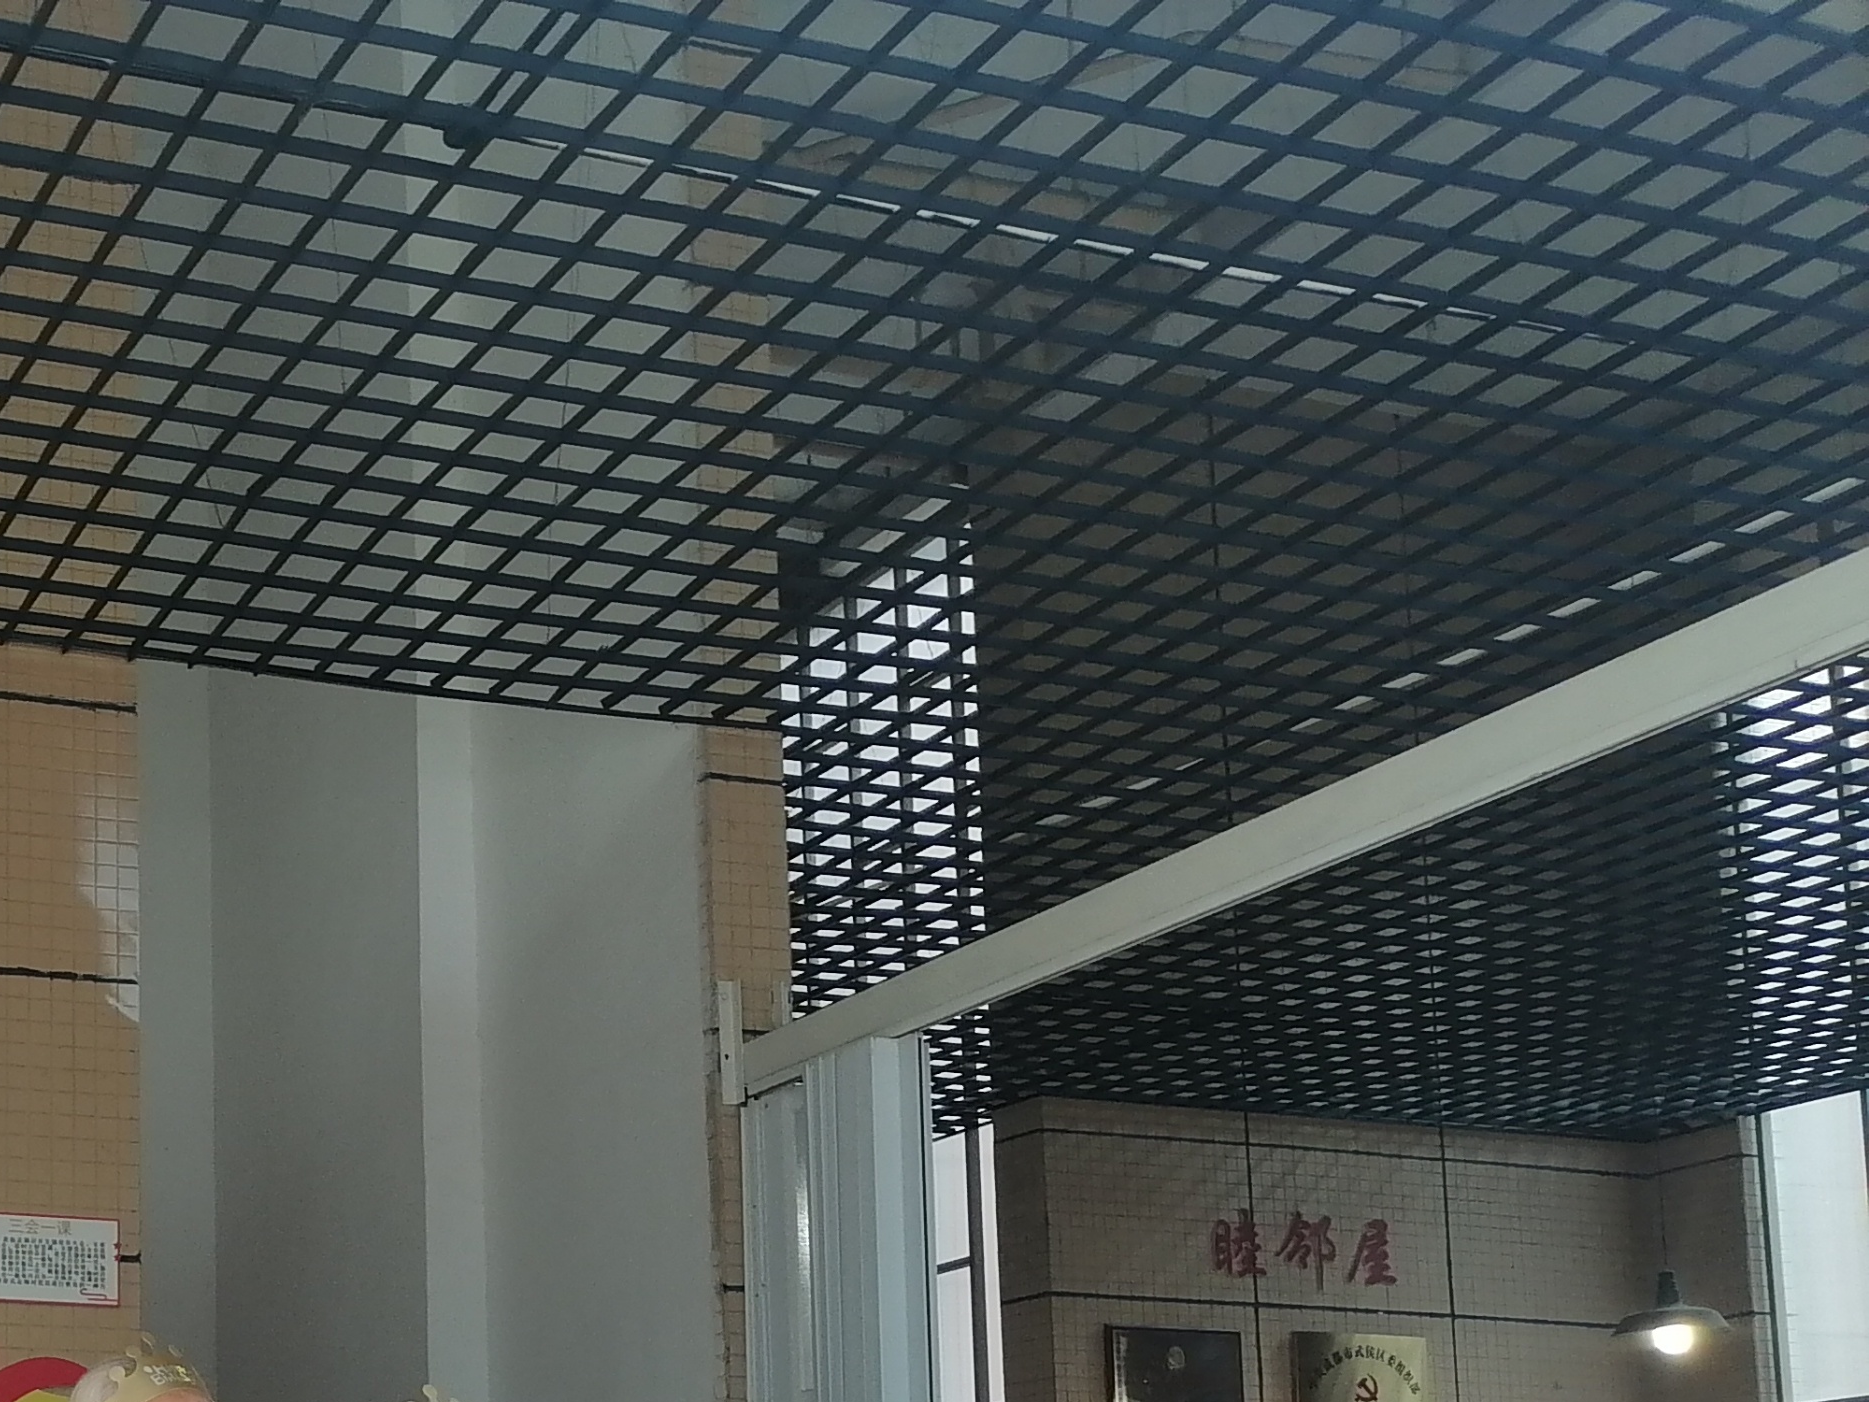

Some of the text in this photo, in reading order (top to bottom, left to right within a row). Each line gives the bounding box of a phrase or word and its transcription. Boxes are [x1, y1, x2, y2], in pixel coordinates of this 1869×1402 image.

[7, 1217, 73, 1237] 三会一课
[1209, 1208, 1399, 1293] 睦邻屋
